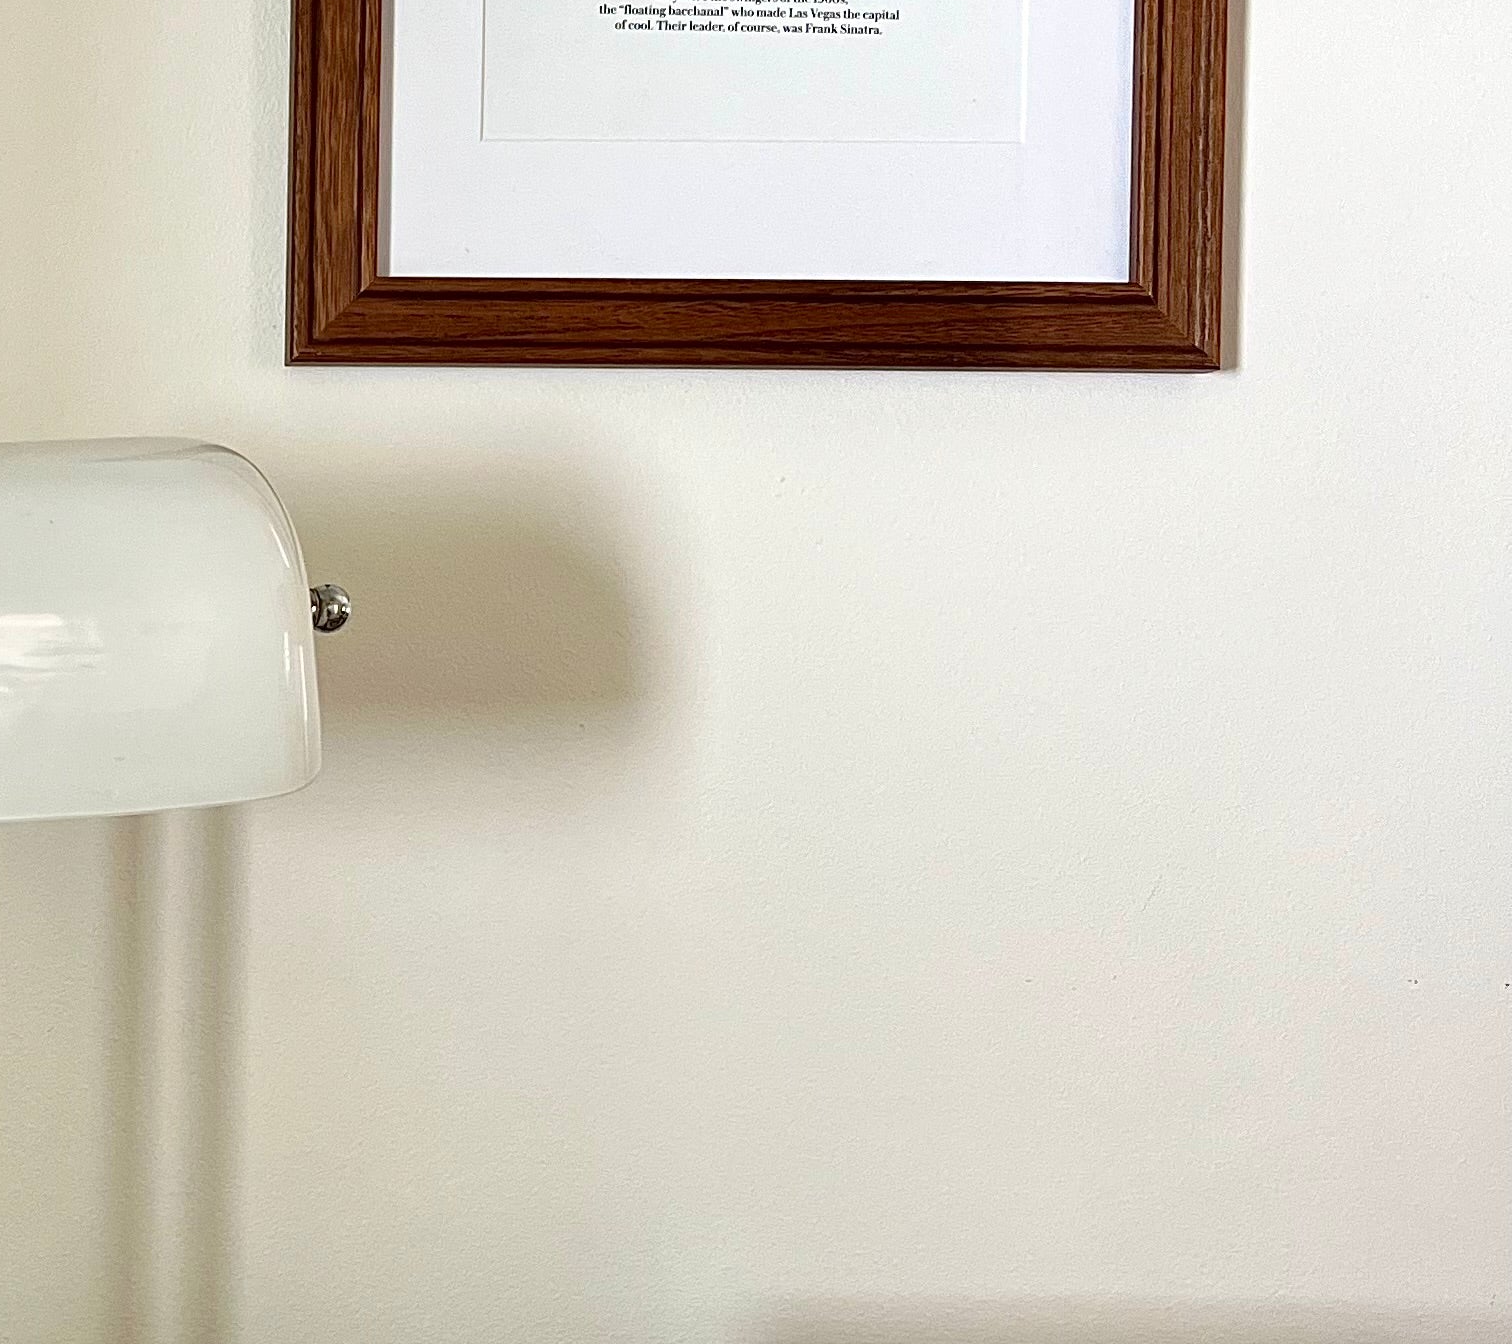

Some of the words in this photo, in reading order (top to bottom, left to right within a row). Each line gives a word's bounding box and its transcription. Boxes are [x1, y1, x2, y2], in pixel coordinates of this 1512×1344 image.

[599, 3, 617, 15] the
[731, 6, 754, 17] who
[756, 7, 786, 18] made
[789, 7, 808, 18] Las
[810, 8, 841, 21] Vegas
[843, 8, 861, 19] the
[862, 9, 900, 23] capital
[614, 19, 628, 30] of
[628, 20, 654, 31] cool.
[656, 20, 687, 31] Their
[689, 21, 726, 32] leader,
[727, 21, 741, 32] of
[740, 24, 781, 33] course,
[782, 25, 803, 33] was
[805, 23, 838, 34] Frank
[840, 23, 883, 35] Sinatra.
